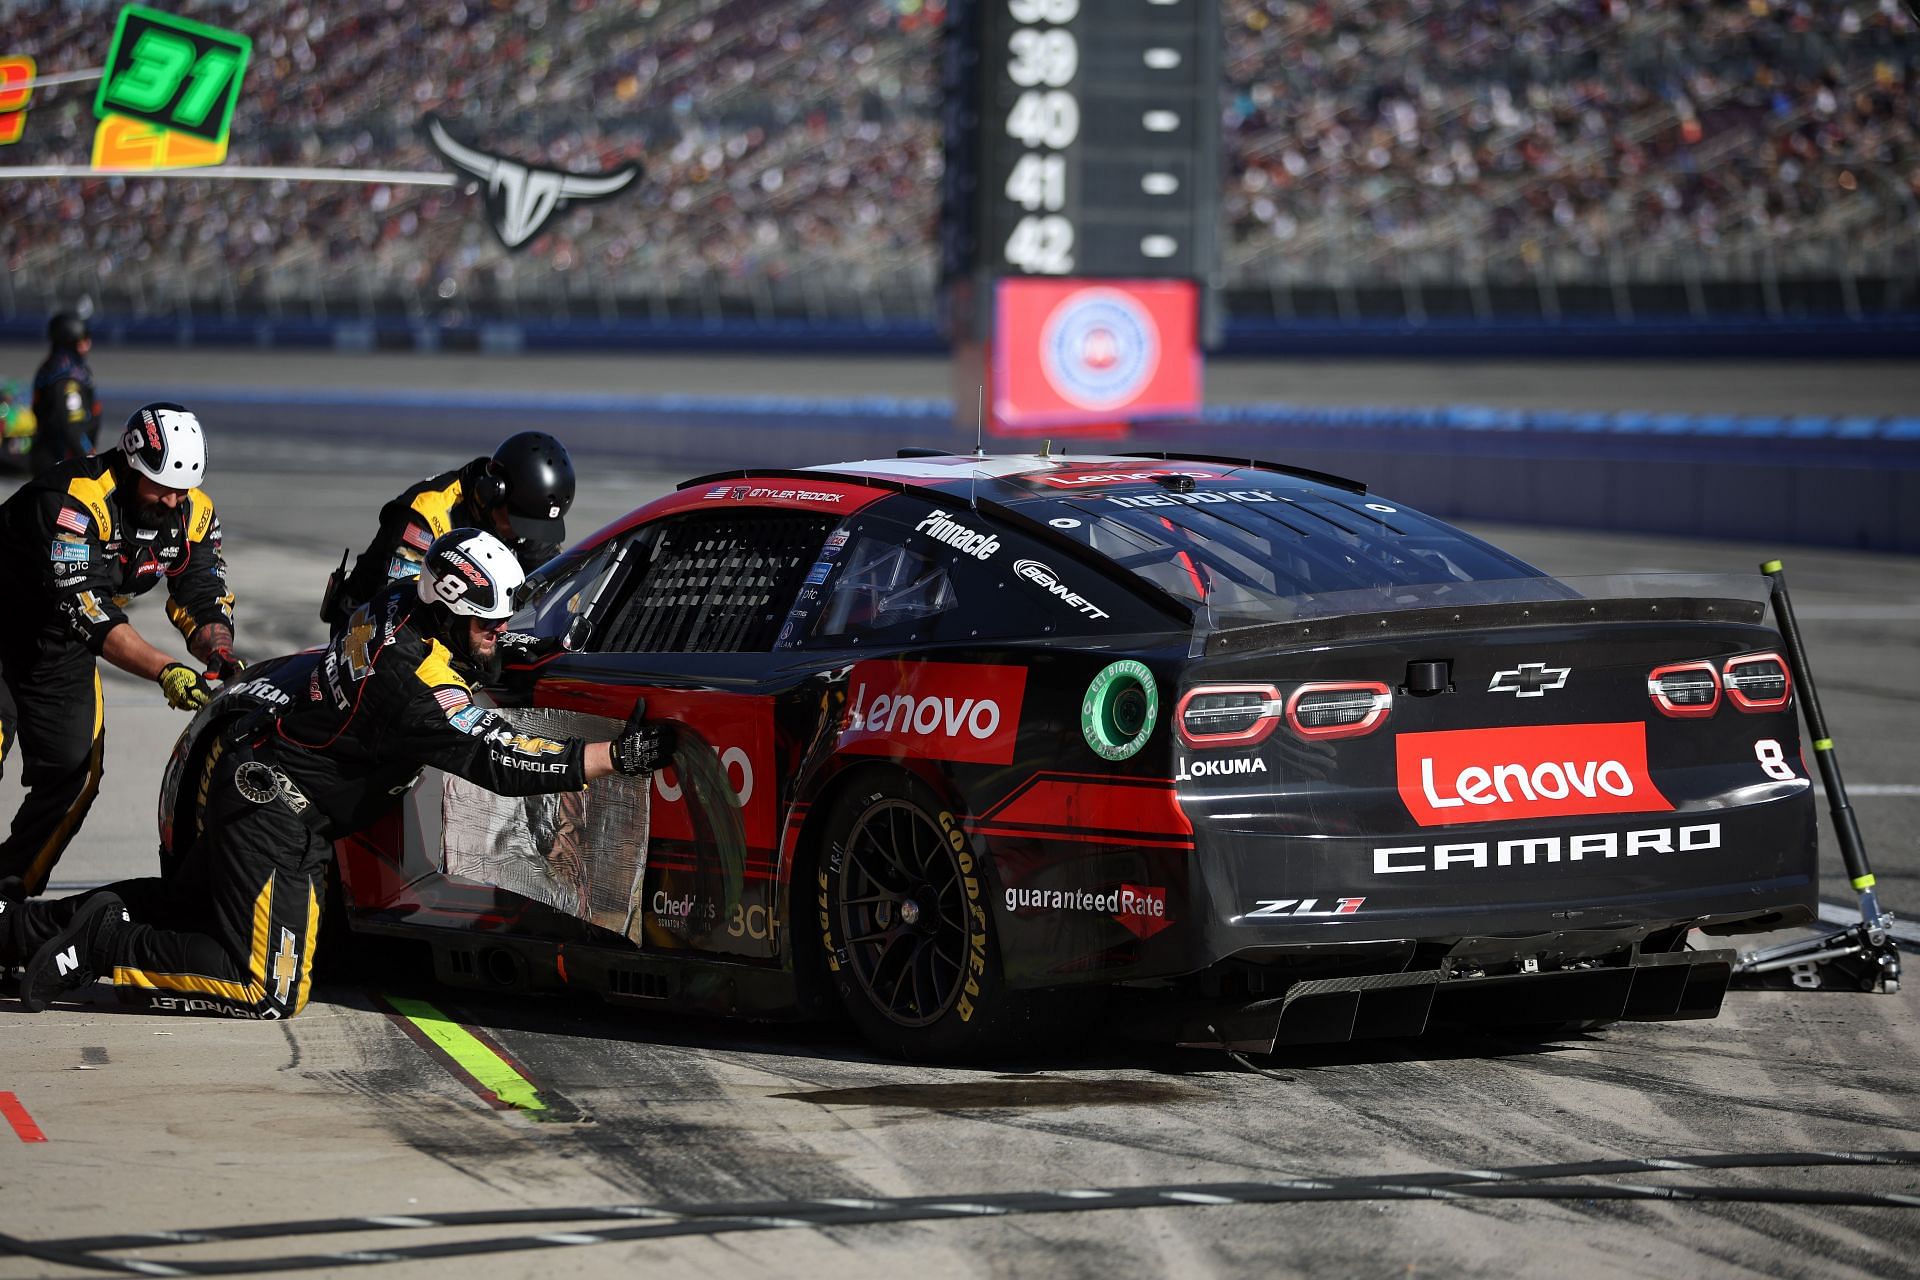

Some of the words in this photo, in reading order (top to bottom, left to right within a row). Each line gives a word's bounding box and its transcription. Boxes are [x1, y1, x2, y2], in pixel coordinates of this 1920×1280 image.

[105, 28, 240, 127] 31
[1007, 28, 1078, 87] 39
[1005, 90, 1080, 149] 40
[1005, 153, 1066, 211] 41
[1004, 215, 1075, 275] 42
[549, 506, 560, 518] 8
[915, 509, 1001, 560] Pinnacle
[69, 561, 89, 573] ptc
[434, 574, 468, 604] 8
[1020, 566, 1110, 620] BENNETT
[1091, 672, 1106, 692] GET
[1108, 662, 1155, 694] BIOETHANOL
[849, 682, 1000, 740] Lenovo
[1191, 757, 1267, 777] OKUMA
[1420, 757, 1634, 809] Lenovo
[1754, 739, 1795, 780] 8
[1373, 823, 1721, 874] CAMARO
[818, 865, 841, 972] EAGLE
[1246, 896, 1367, 919] ZL1
[1791, 961, 1822, 988] 8
